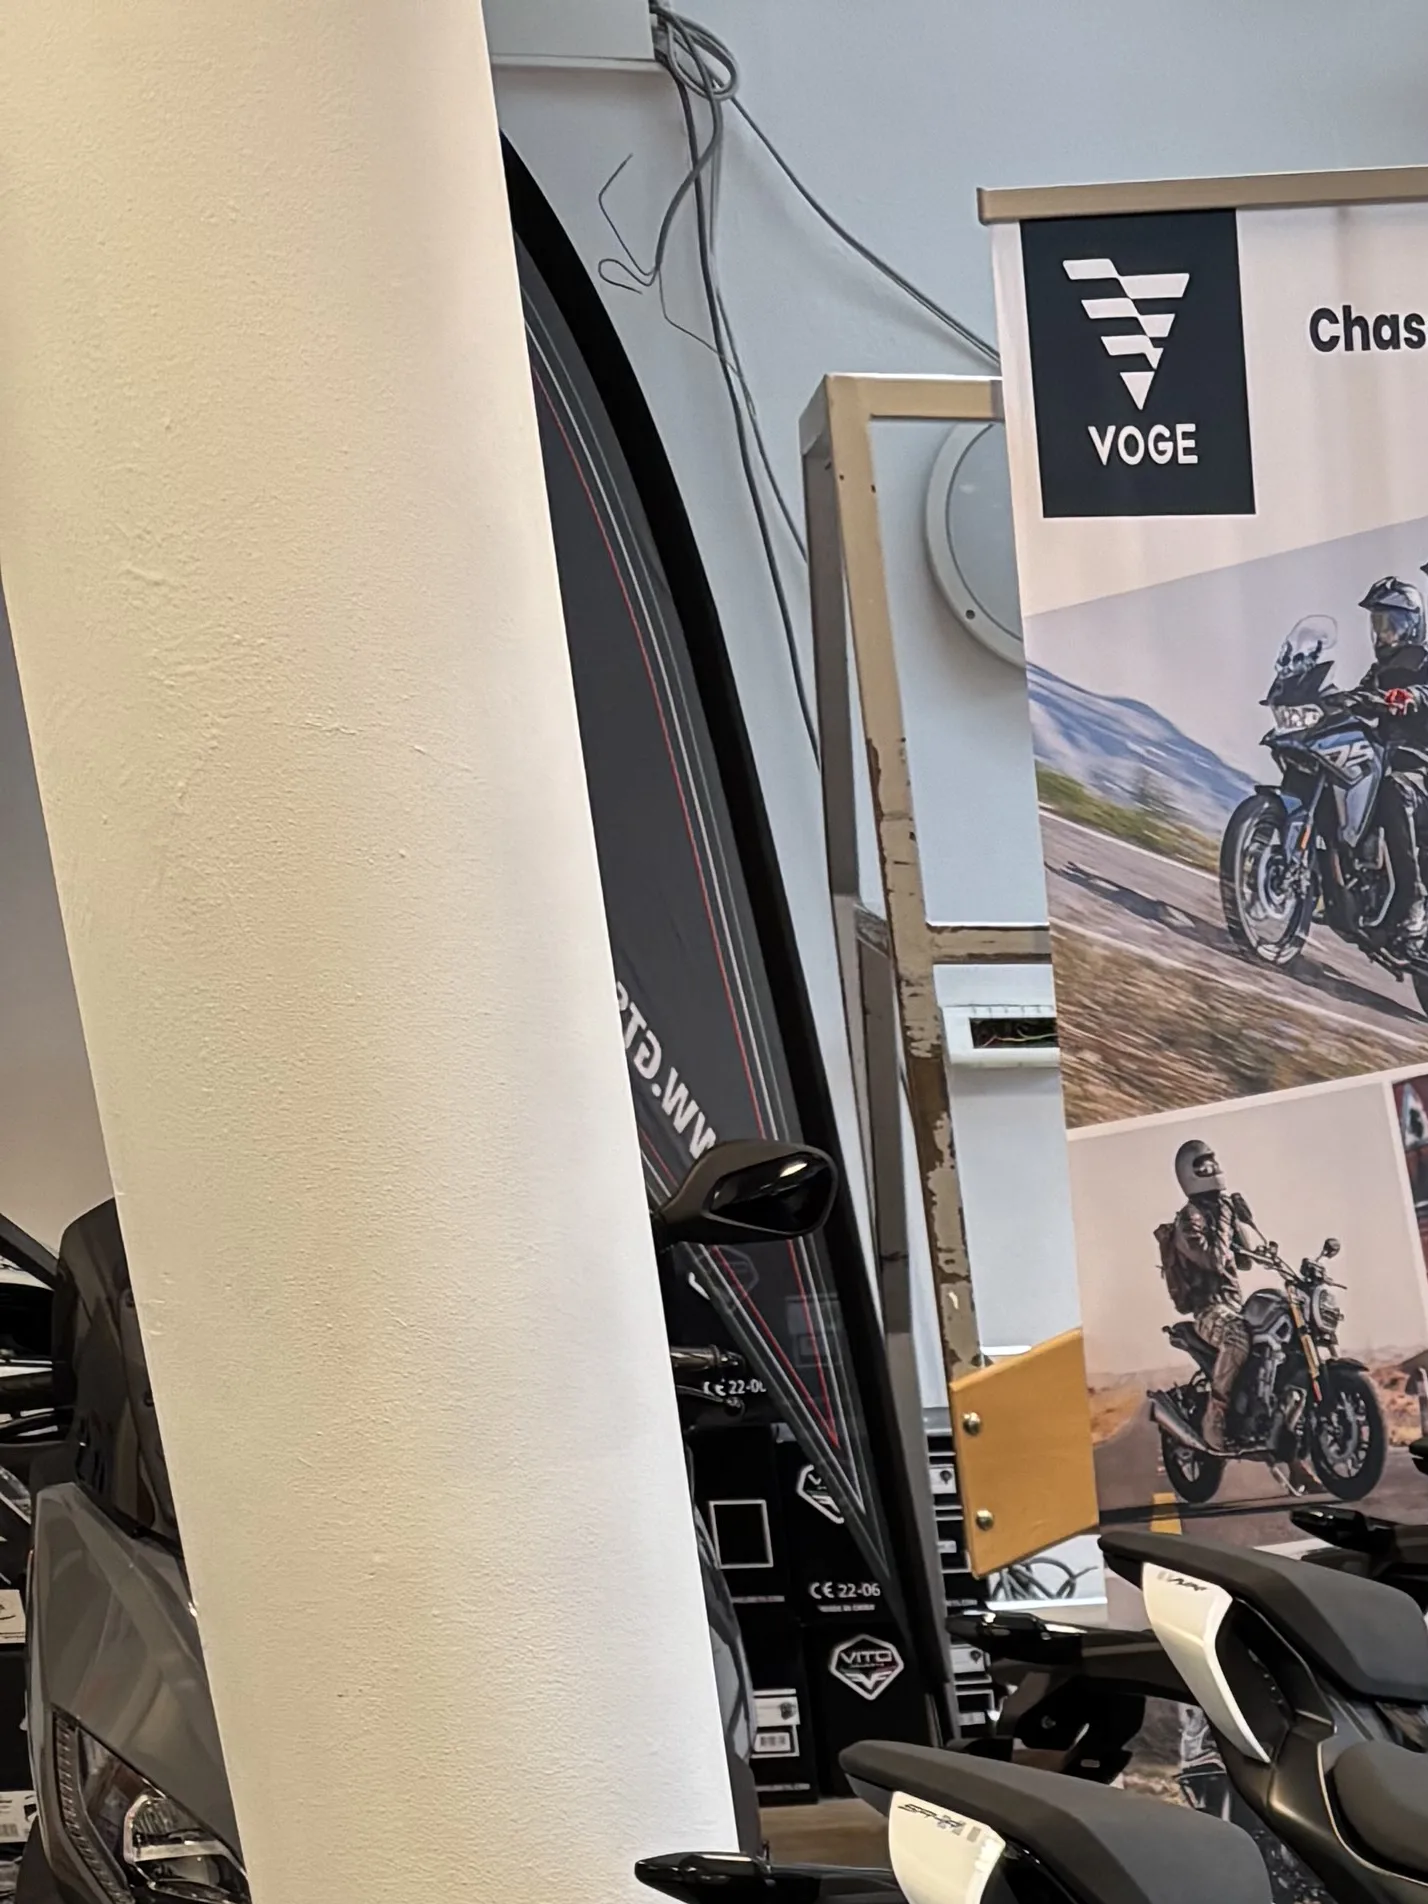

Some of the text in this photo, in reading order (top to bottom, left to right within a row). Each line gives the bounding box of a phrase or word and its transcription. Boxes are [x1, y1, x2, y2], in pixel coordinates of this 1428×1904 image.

[1088, 423, 1198, 466] VOGE
[837, 1582, 881, 1598] 22-06
[840, 1650, 892, 1664] VITO
